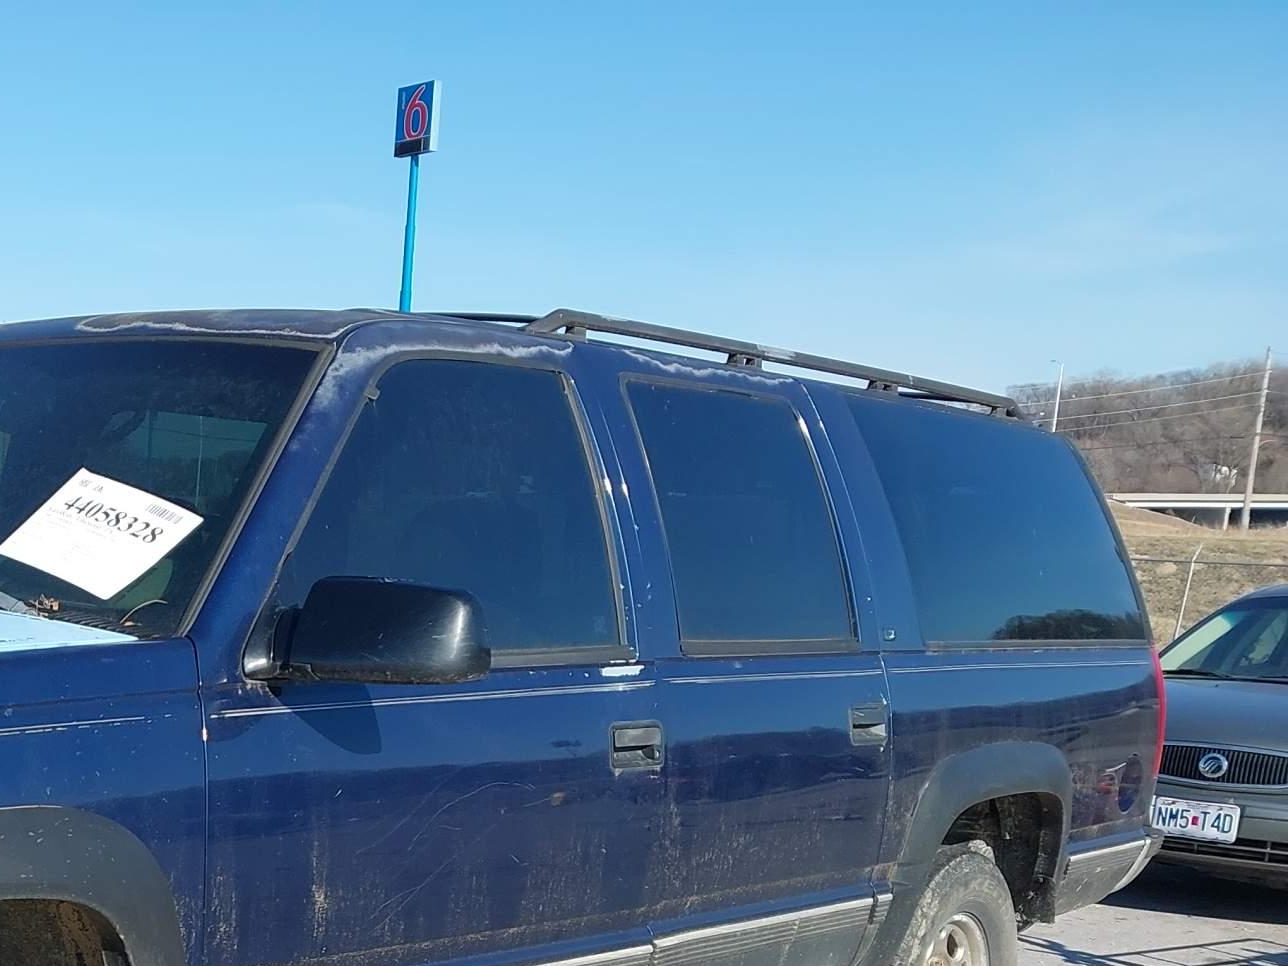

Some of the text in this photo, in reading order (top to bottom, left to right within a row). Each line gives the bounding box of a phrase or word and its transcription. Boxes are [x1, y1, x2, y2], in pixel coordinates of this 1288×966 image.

[405, 85, 428, 140] 6
[64, 496, 164, 543] 44058328
[1156, 806, 1191, 829] NM5
